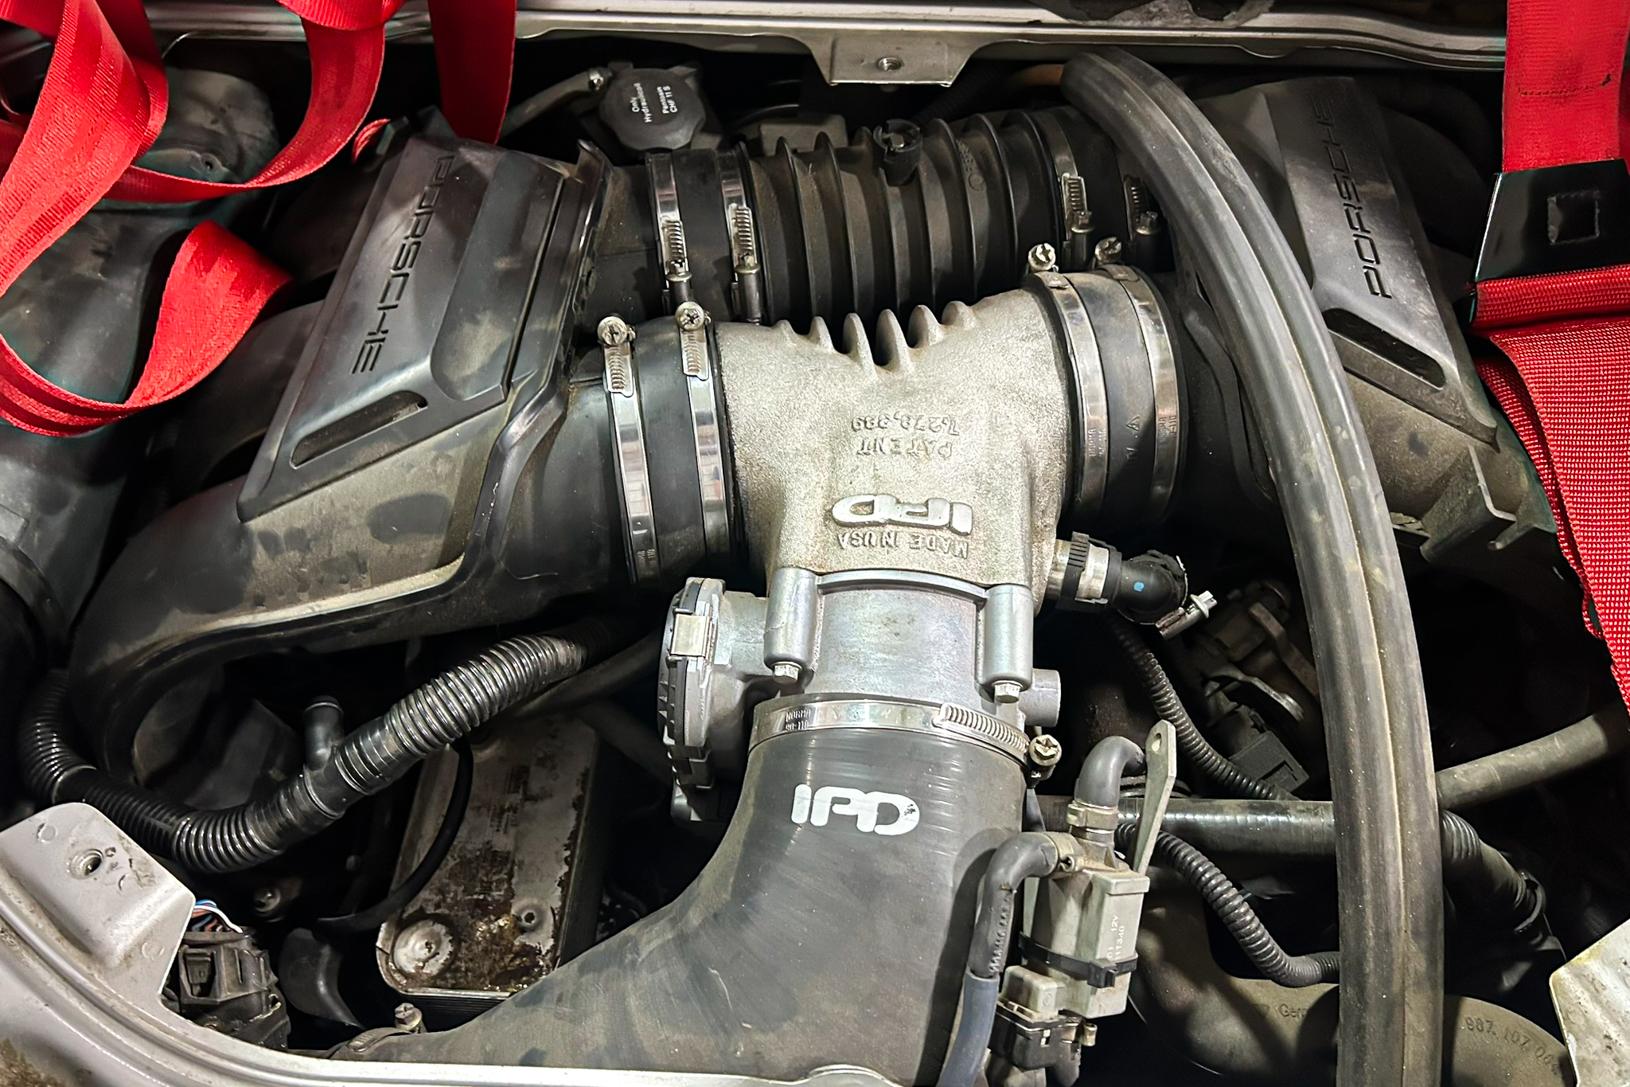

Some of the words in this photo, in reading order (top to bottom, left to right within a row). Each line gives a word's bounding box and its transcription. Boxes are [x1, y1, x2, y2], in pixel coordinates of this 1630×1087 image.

[1311, 97, 1392, 299] PORSCHE
[352, 155, 455, 374] PORSCHE
[856, 437, 953, 460] PATENT
[831, 494, 973, 537] IPD
[837, 530, 877, 550] USA
[909, 534, 969, 560] MADE
[791, 784, 920, 836] IPD
